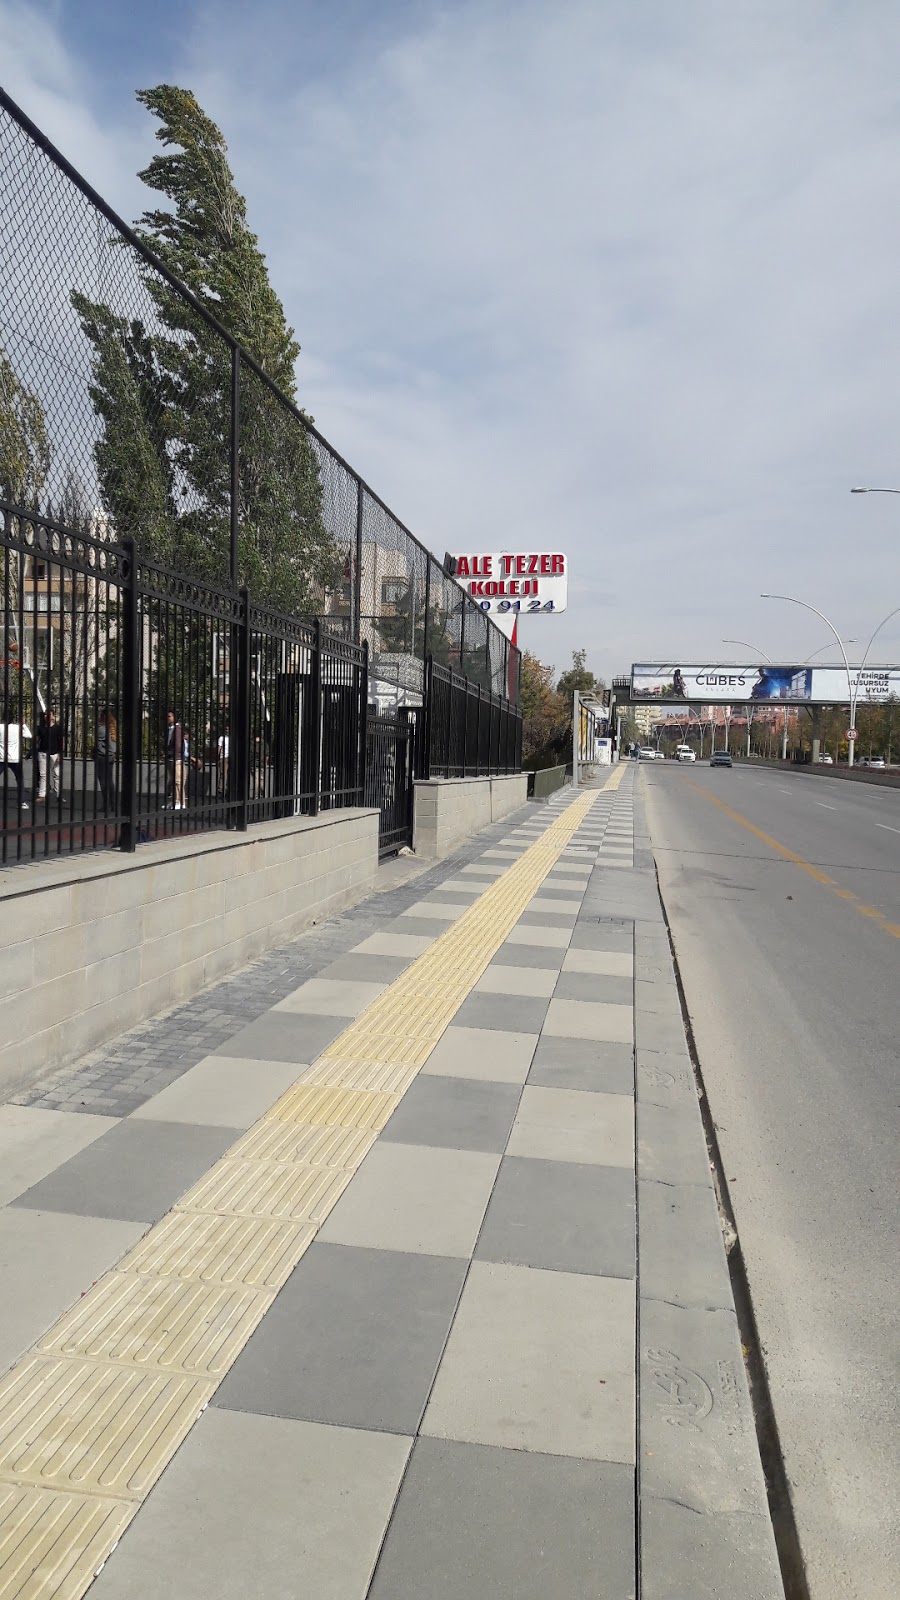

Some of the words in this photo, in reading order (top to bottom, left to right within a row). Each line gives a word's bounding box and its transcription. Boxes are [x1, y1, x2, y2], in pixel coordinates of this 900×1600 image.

[452, 556, 492, 576] ALE
[502, 554, 565, 575] TEZER
[471, 577, 539, 596] KOLEJİ
[530, 600, 554, 611] 24
[695, 675, 746, 686] CUBES
